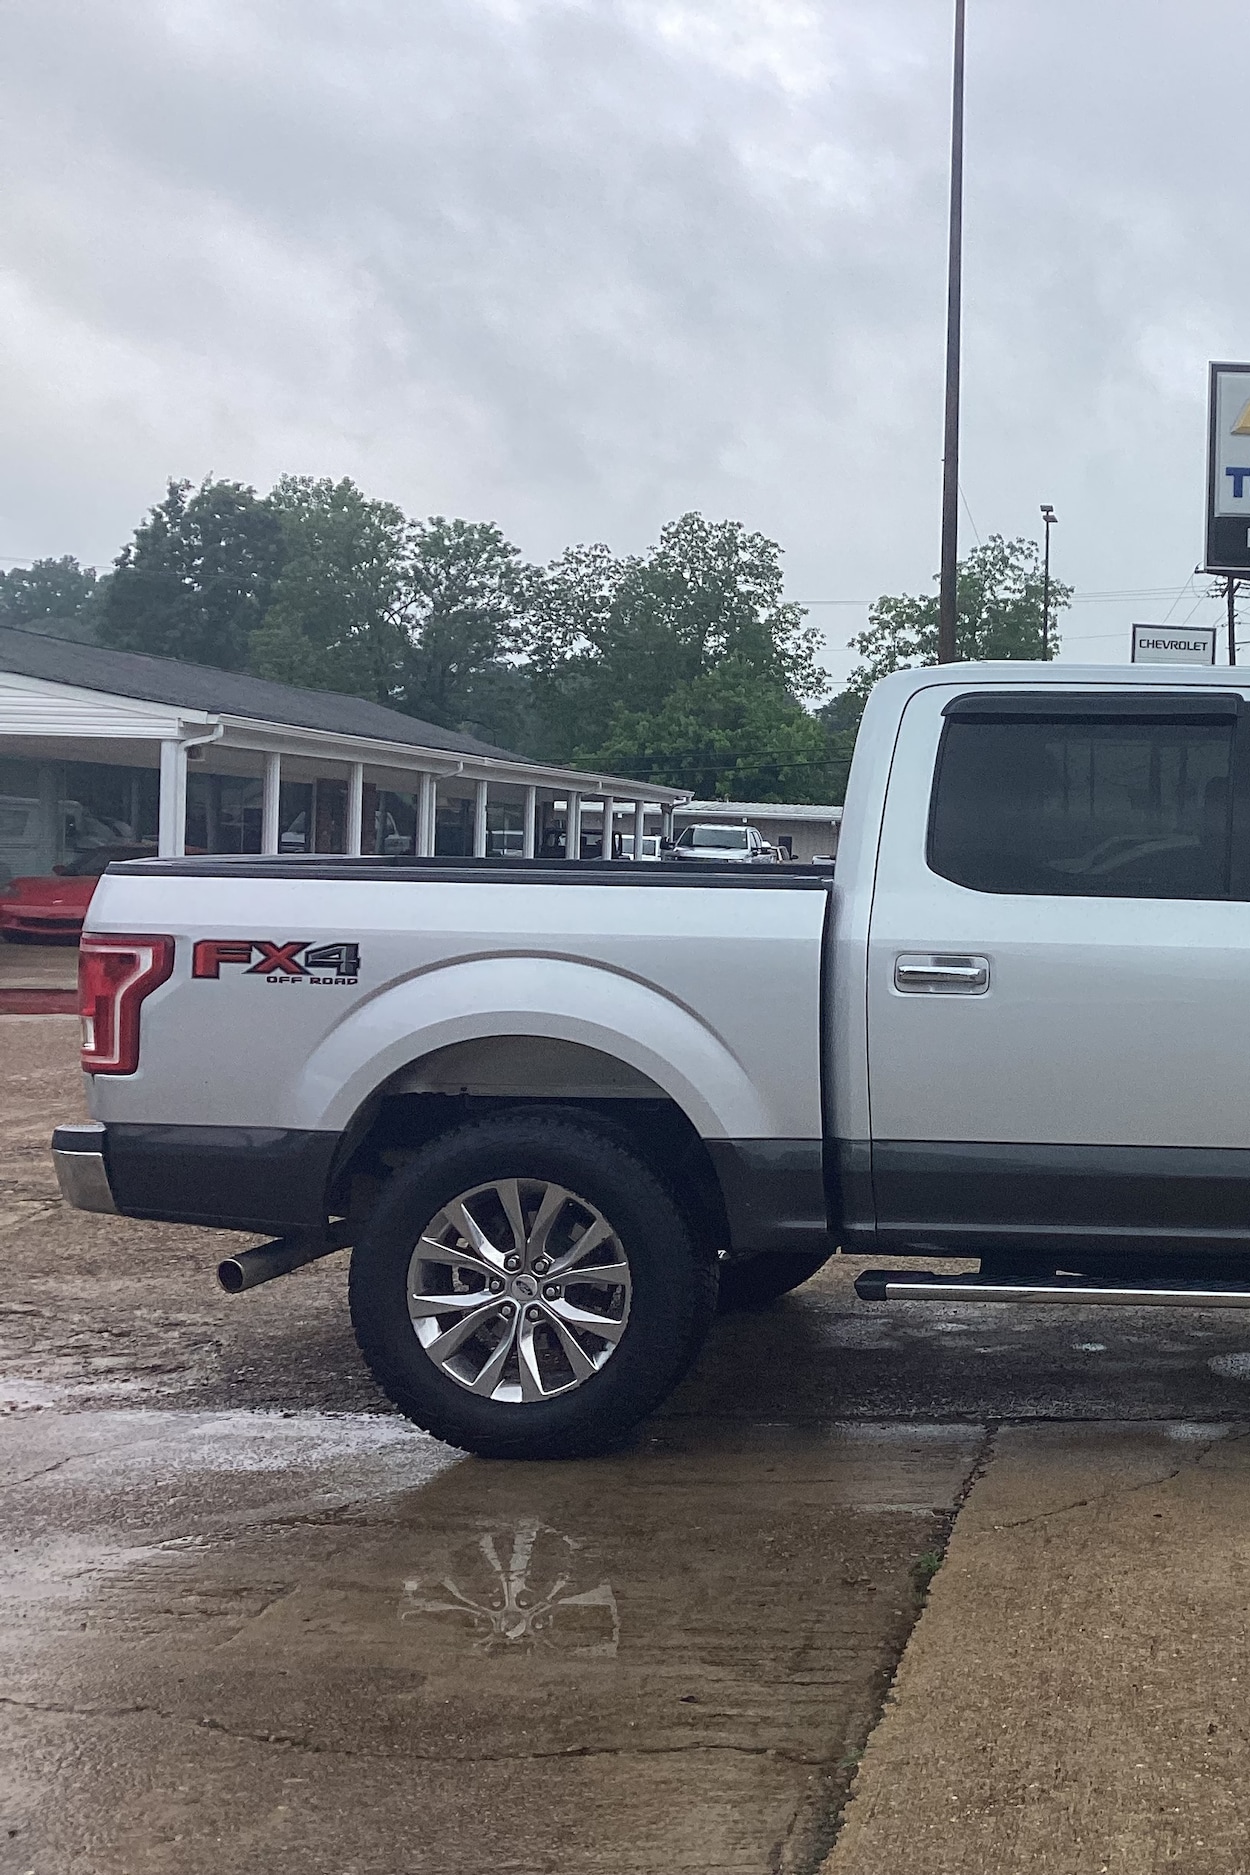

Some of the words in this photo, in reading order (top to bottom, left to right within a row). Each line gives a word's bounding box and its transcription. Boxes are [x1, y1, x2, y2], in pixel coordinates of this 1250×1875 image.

[1138, 638, 1208, 652] CHEVROLET
[192, 939, 361, 980] FX4
[266, 976, 303, 984] OFF
[309, 977, 358, 985] ROAD
